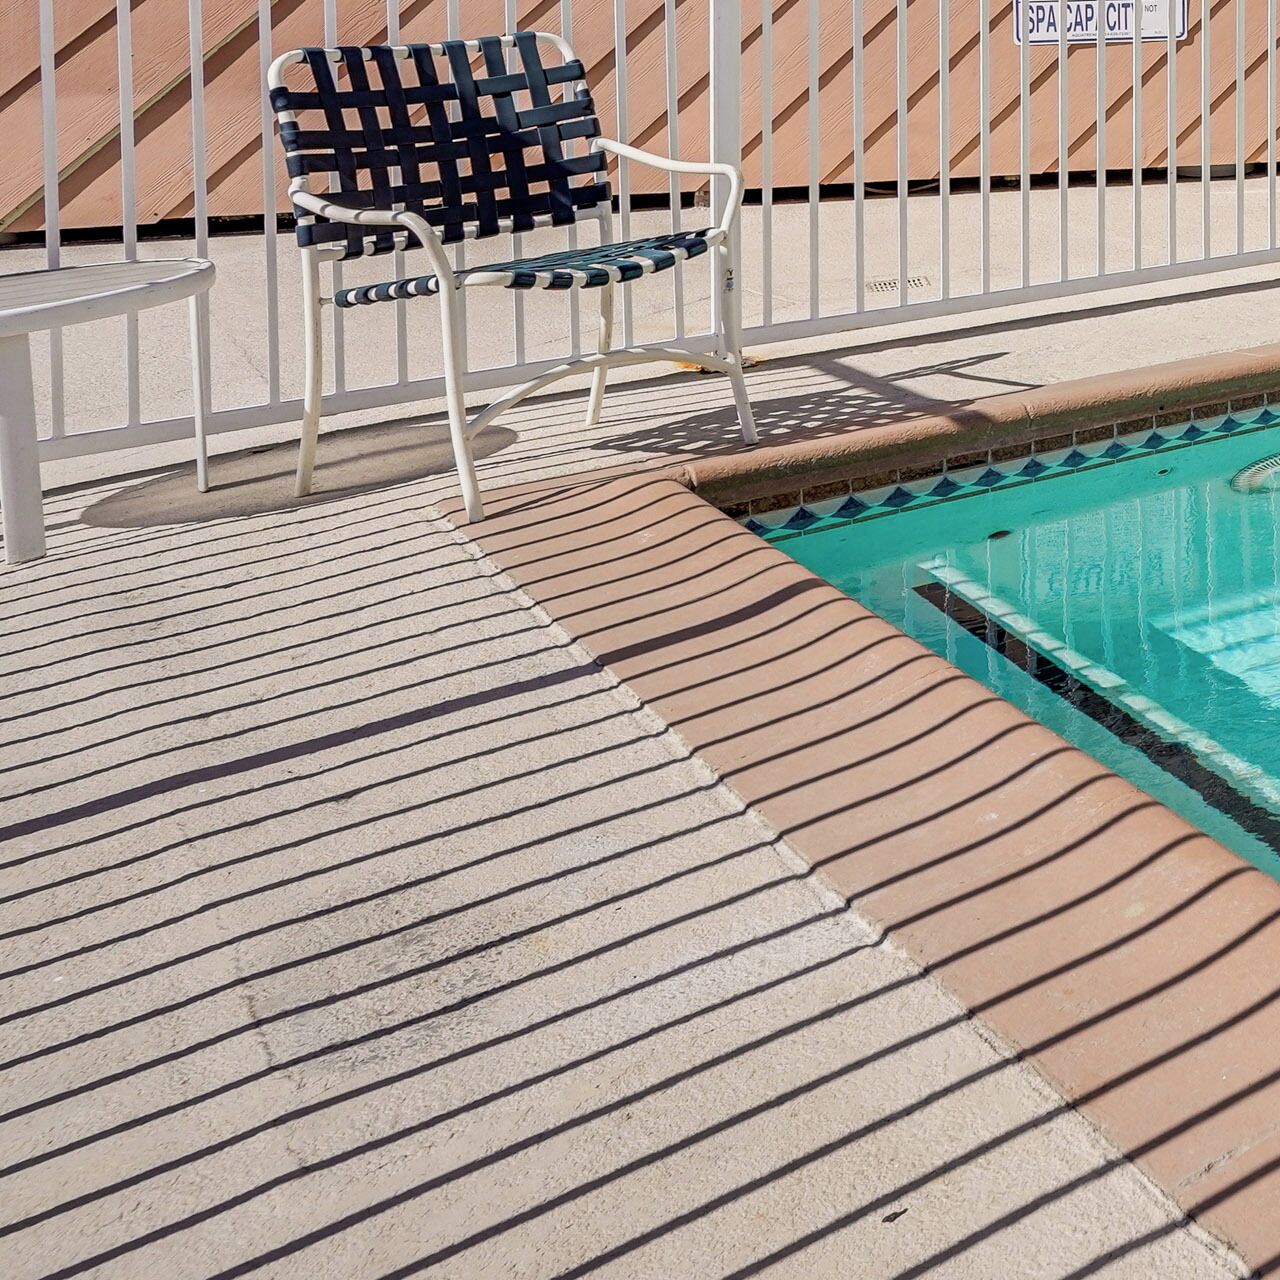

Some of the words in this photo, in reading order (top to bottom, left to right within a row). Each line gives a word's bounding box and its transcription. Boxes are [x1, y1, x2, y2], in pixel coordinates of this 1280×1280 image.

[1028, 5, 1058, 34] SPA
[1066, 3, 1134, 32] CAPCIT
[1144, 4, 1158, 13] NOT
